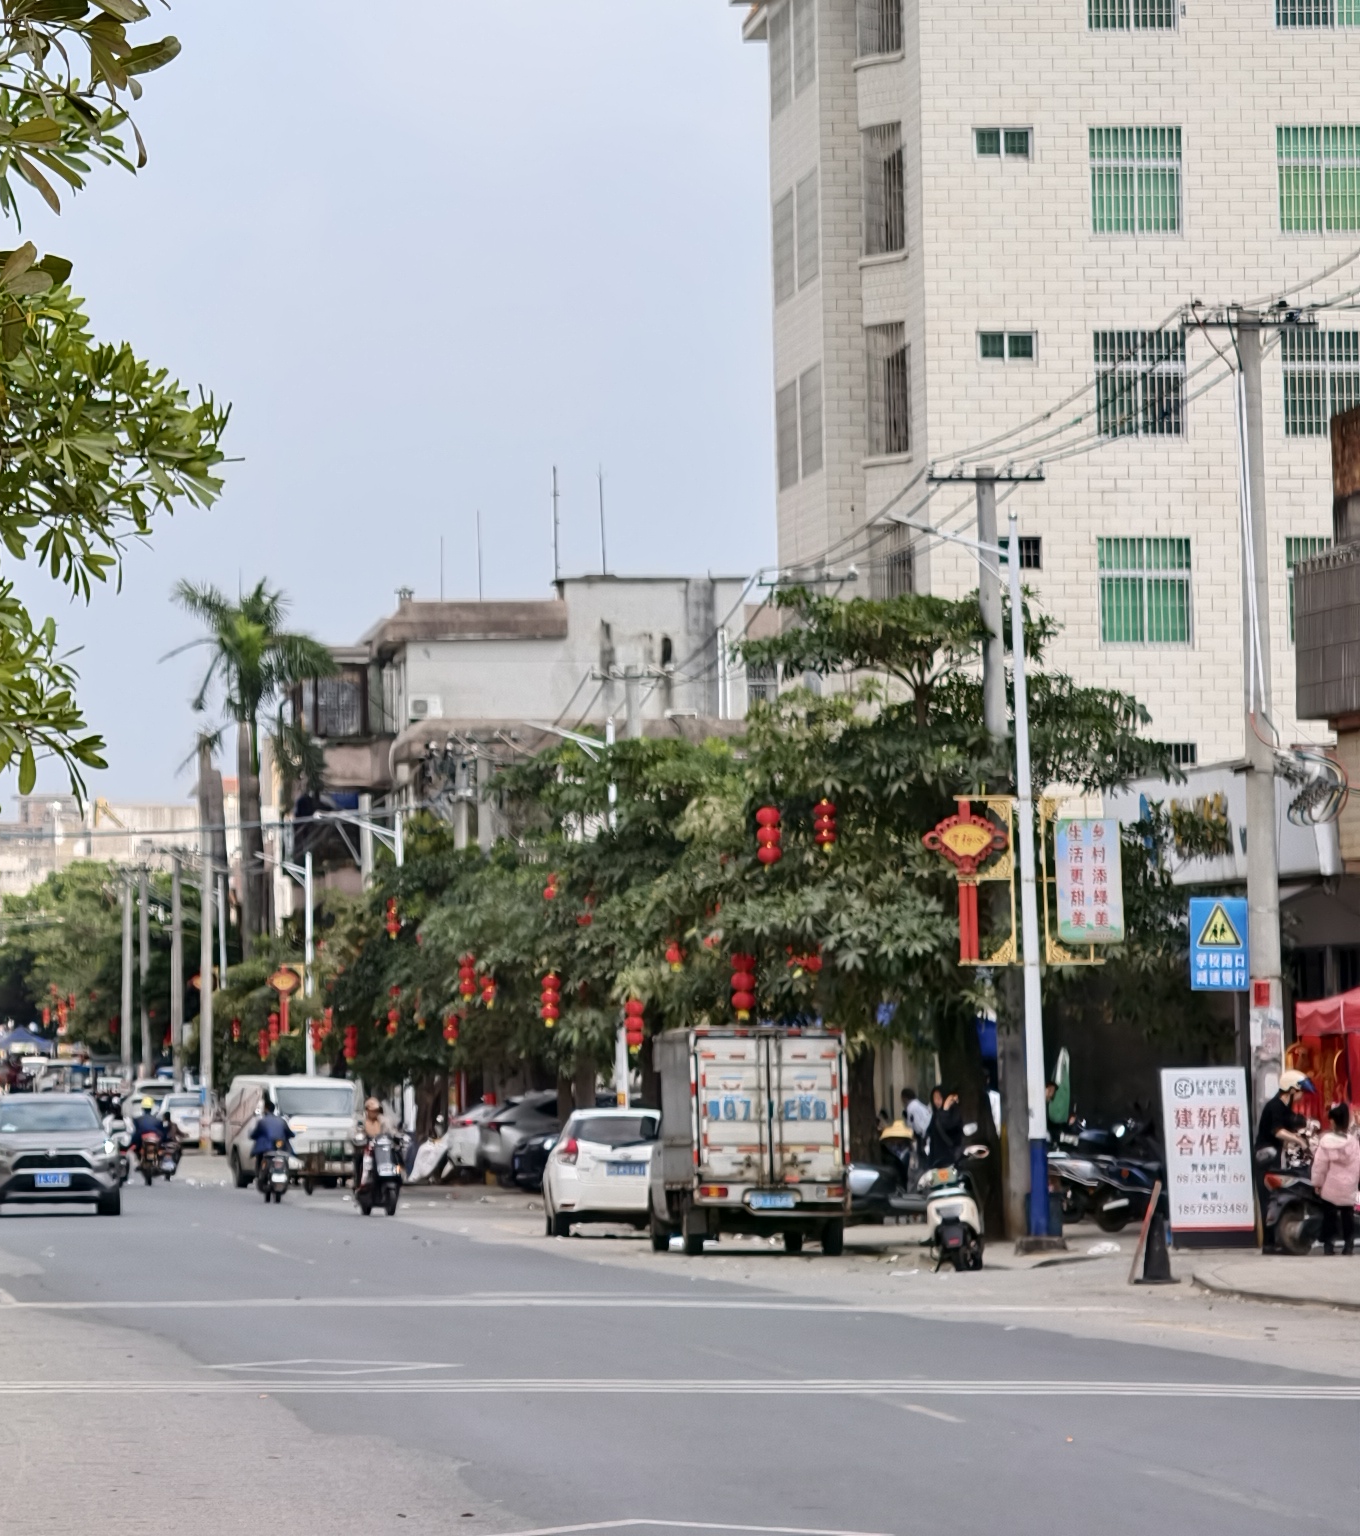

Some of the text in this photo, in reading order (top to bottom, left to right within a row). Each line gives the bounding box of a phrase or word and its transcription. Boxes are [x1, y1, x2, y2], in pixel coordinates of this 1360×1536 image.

[1068, 823, 1086, 928] 生活更甜美
[1092, 823, 1109, 928] 乡村添绿美
[1196, 953, 1245, 969] 学校路口
[1196, 970, 1245, 987] 减速慢行
[1174, 1106, 1240, 1129] 建新镇
[1176, 1134, 1242, 1156] 合作点
